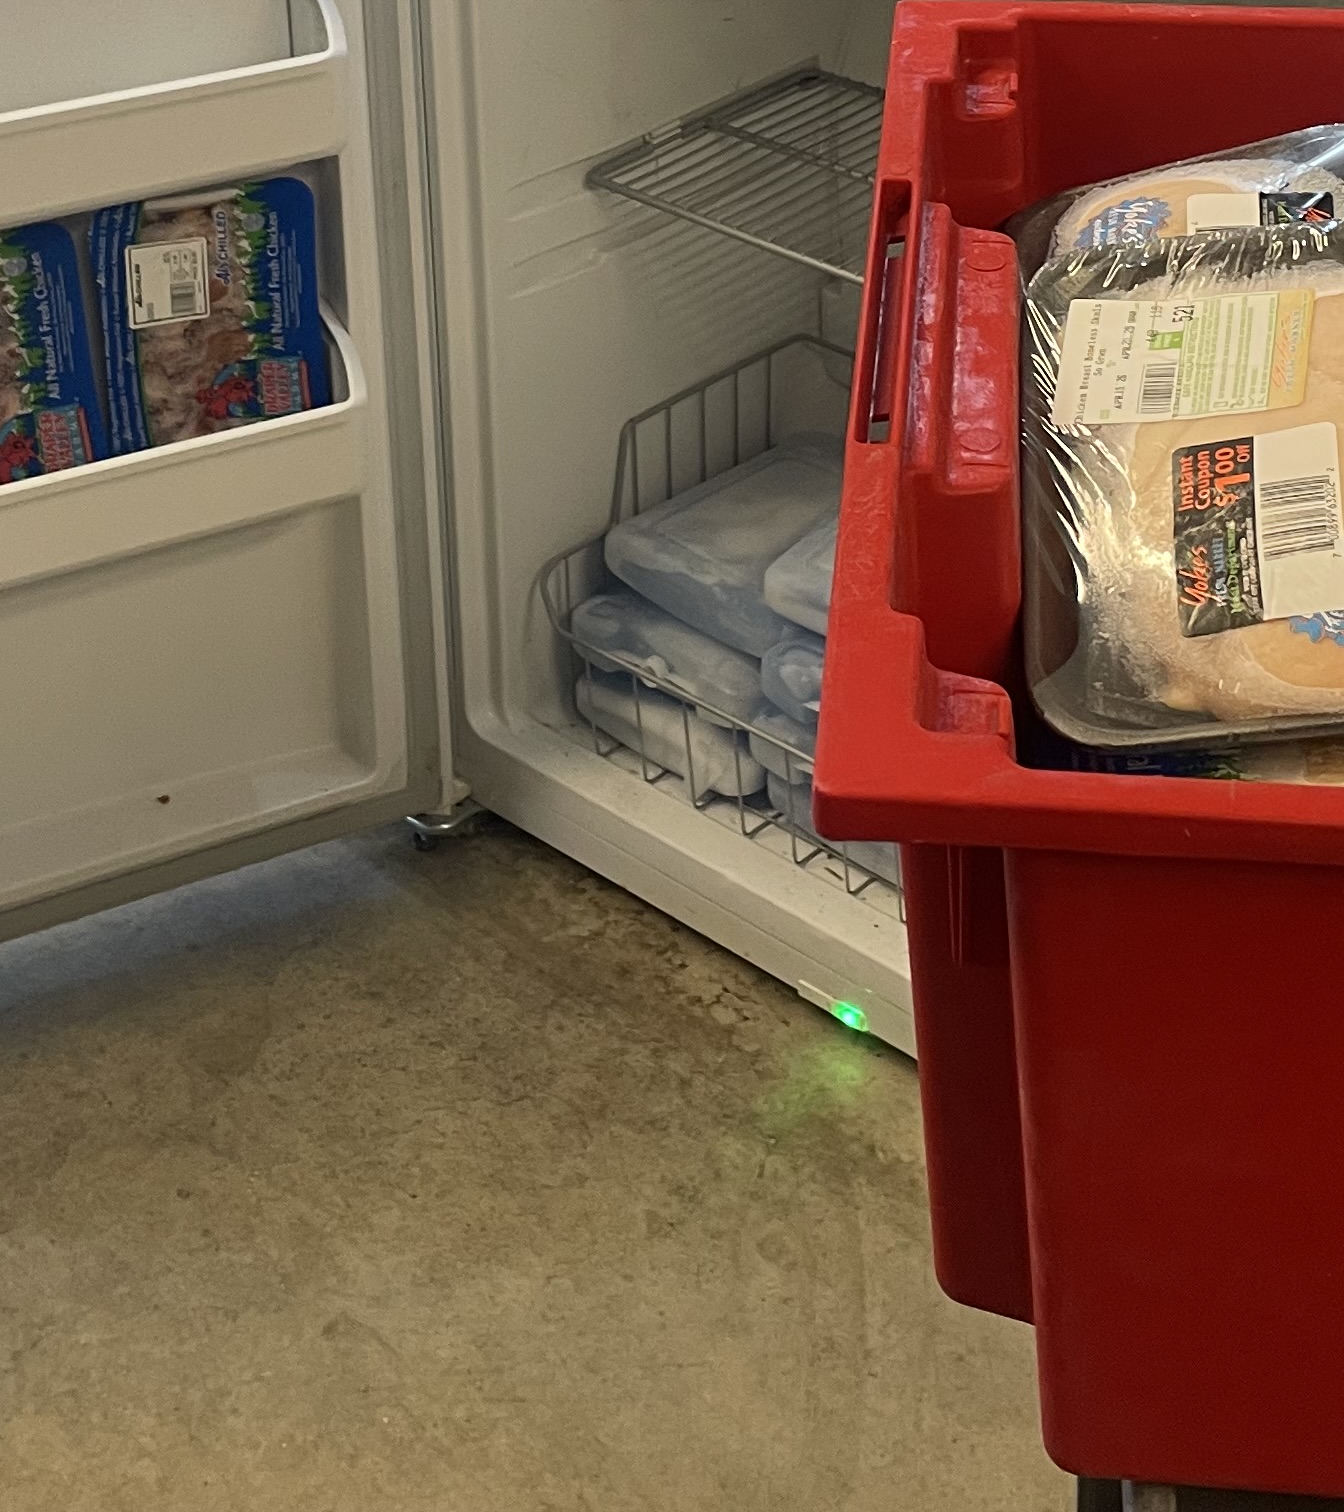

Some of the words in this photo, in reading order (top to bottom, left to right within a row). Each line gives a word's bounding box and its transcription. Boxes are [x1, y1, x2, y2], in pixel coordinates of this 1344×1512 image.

[214, 210, 229, 259] CHILLED
[267, 257, 281, 289] Fresh
[38, 300, 53, 333] Fresh
[269, 291, 285, 334] Natural
[44, 337, 60, 382] Natural
[272, 334, 286, 351] All
[47, 382, 61, 400] All
[261, 360, 277, 415] DRAPER
[276, 362, 292, 411] VALLEY
[1236, 444, 1251, 463] Off
[1177, 454, 1194, 512] Instant
[1194, 450, 1214, 511] Coupon
